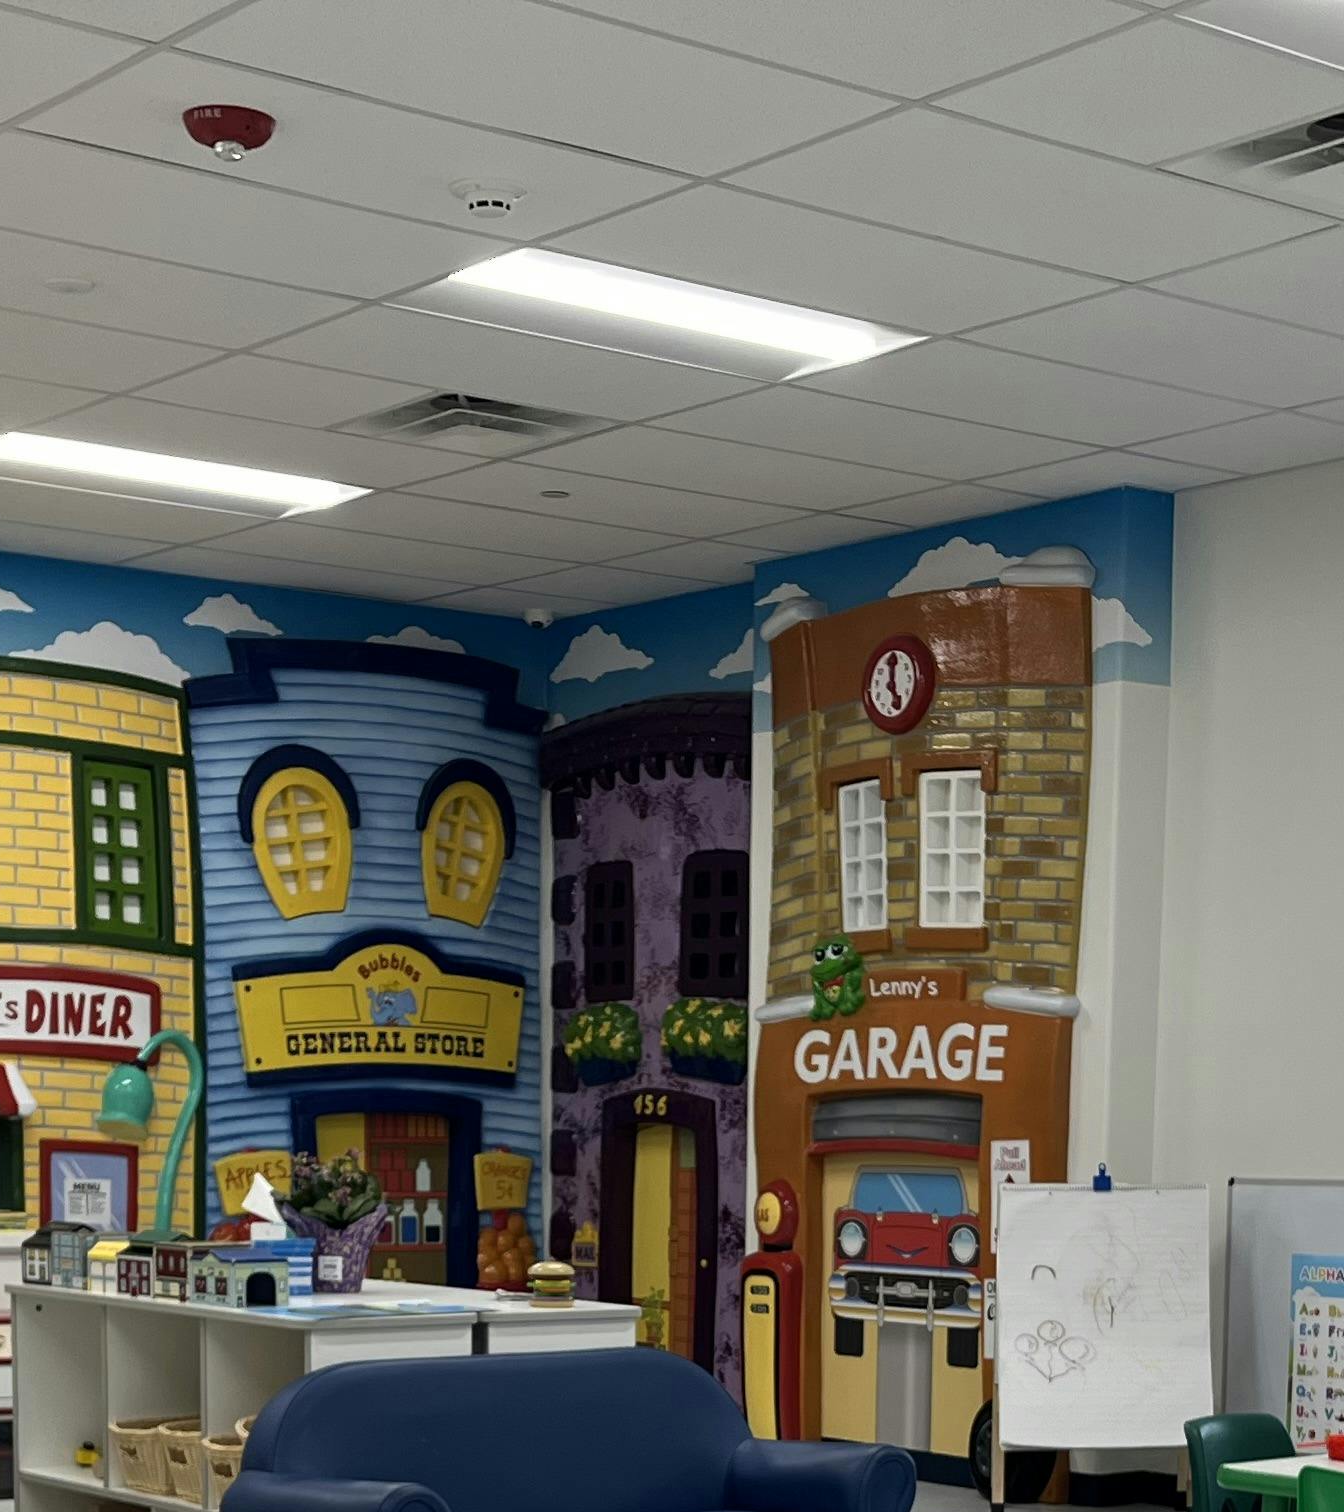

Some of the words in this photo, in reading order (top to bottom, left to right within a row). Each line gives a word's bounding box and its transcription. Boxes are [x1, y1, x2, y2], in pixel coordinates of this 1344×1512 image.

[193, 108, 222, 120] FIRE
[357, 953, 421, 983] Bubbles
[868, 976, 939, 998] Lenny's
[24, 988, 133, 1040] DINER
[286, 1030, 406, 1056] GENERAL
[414, 1032, 485, 1058] STORE
[793, 1022, 1009, 1084] GARAGE
[633, 1094, 668, 1116] 156
